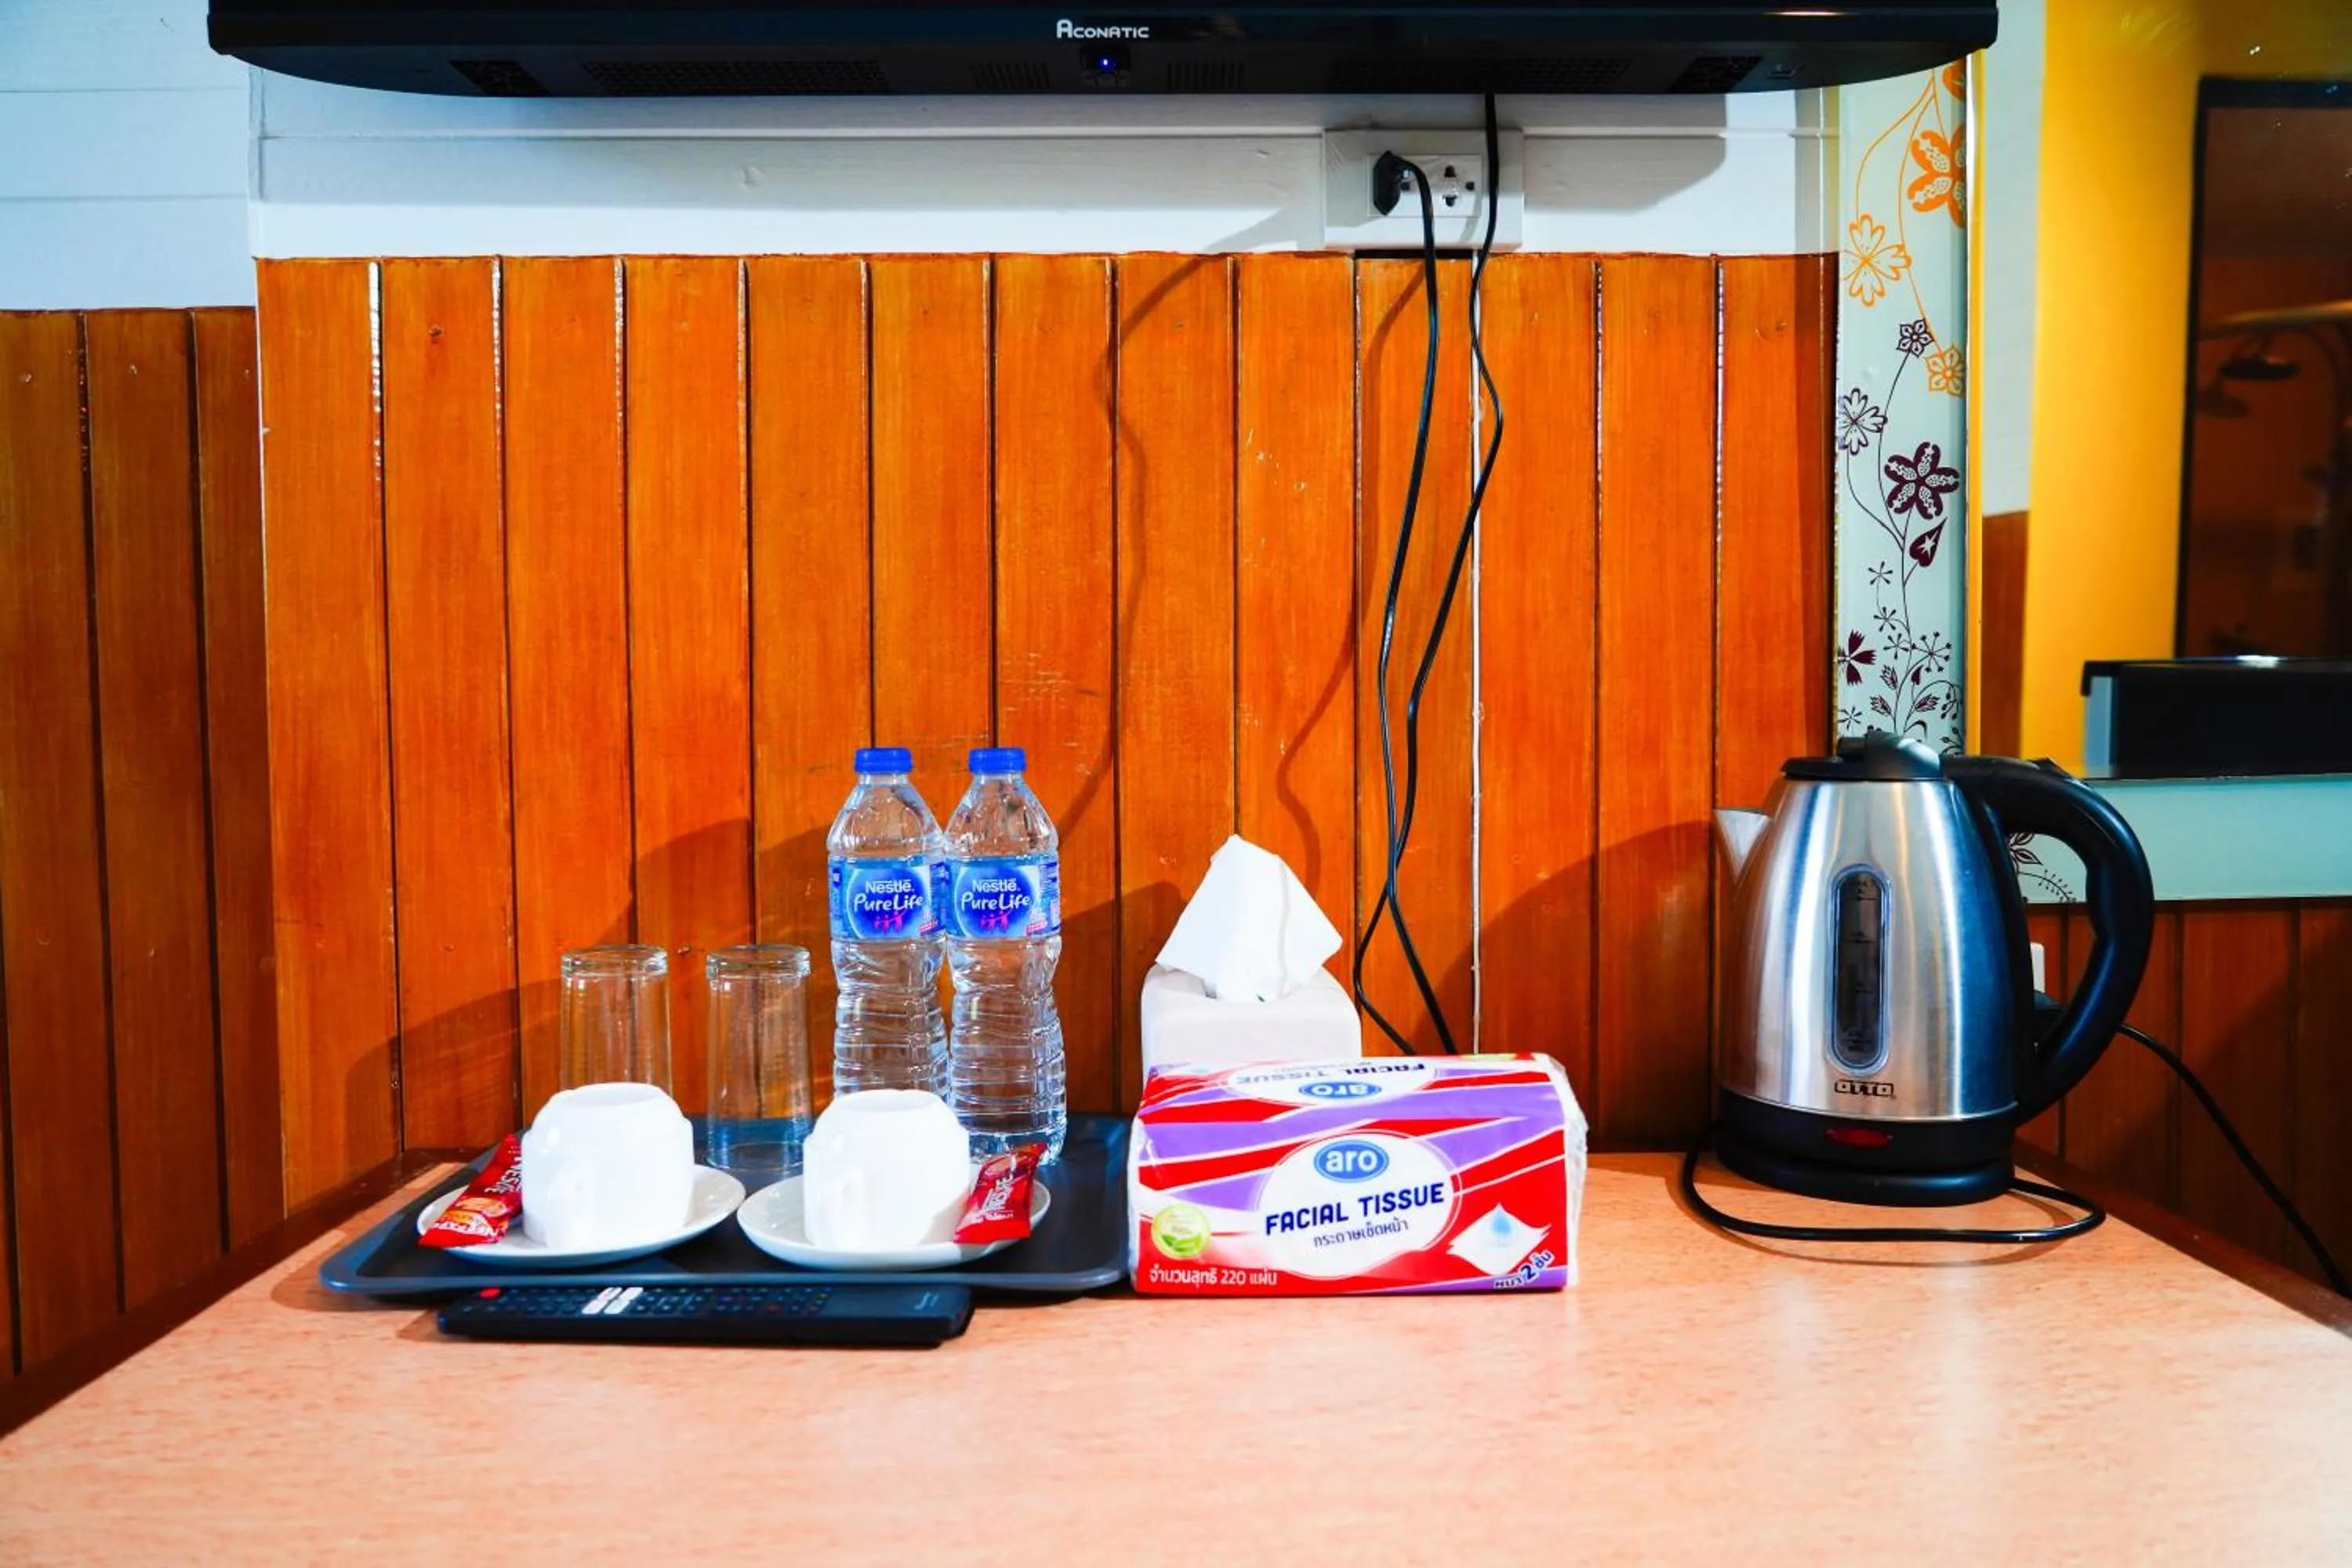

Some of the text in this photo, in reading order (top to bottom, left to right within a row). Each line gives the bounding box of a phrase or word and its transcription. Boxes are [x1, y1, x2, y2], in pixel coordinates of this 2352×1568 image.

[1056, 19, 1149, 38] ACONATIC
[1324, 1148, 1377, 1173] aro
[1265, 1182, 1445, 1236] FACIAL TISSUE
[1220, 1269, 1247, 1285] 220
[1520, 1265, 1536, 1279] 2
